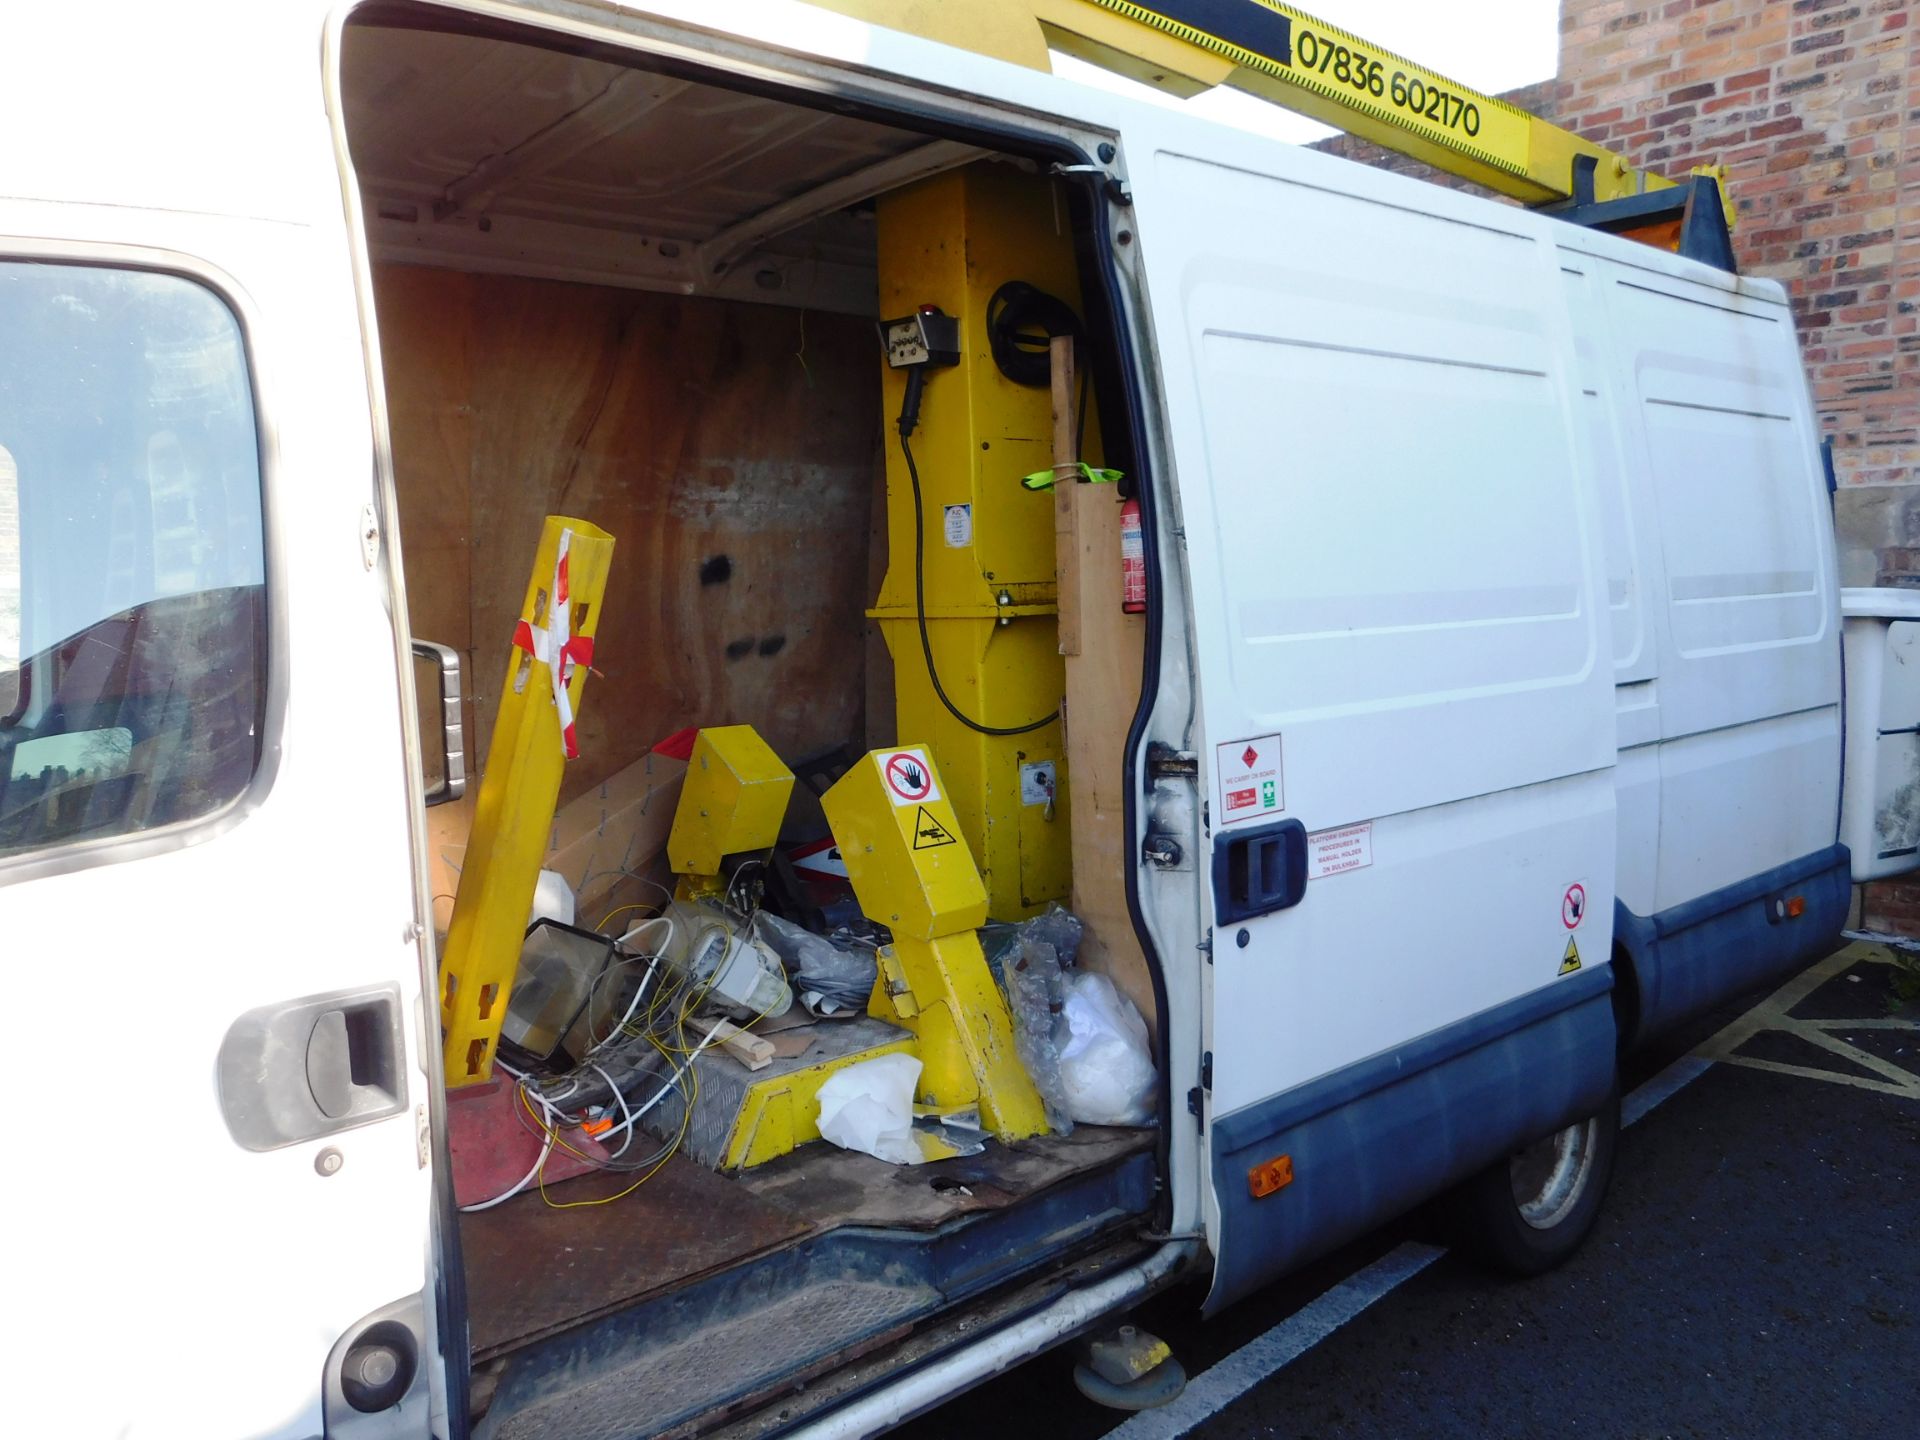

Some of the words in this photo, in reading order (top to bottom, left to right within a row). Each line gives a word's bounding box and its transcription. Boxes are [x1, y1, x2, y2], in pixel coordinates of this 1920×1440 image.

[1297, 30, 1384, 97] 07836
[1391, 71, 1480, 137] 602170
[1309, 833, 1337, 845] PLATFORM
[1318, 840, 1353, 852] PROCEDURES
[1341, 848, 1362, 858] HOLDER
